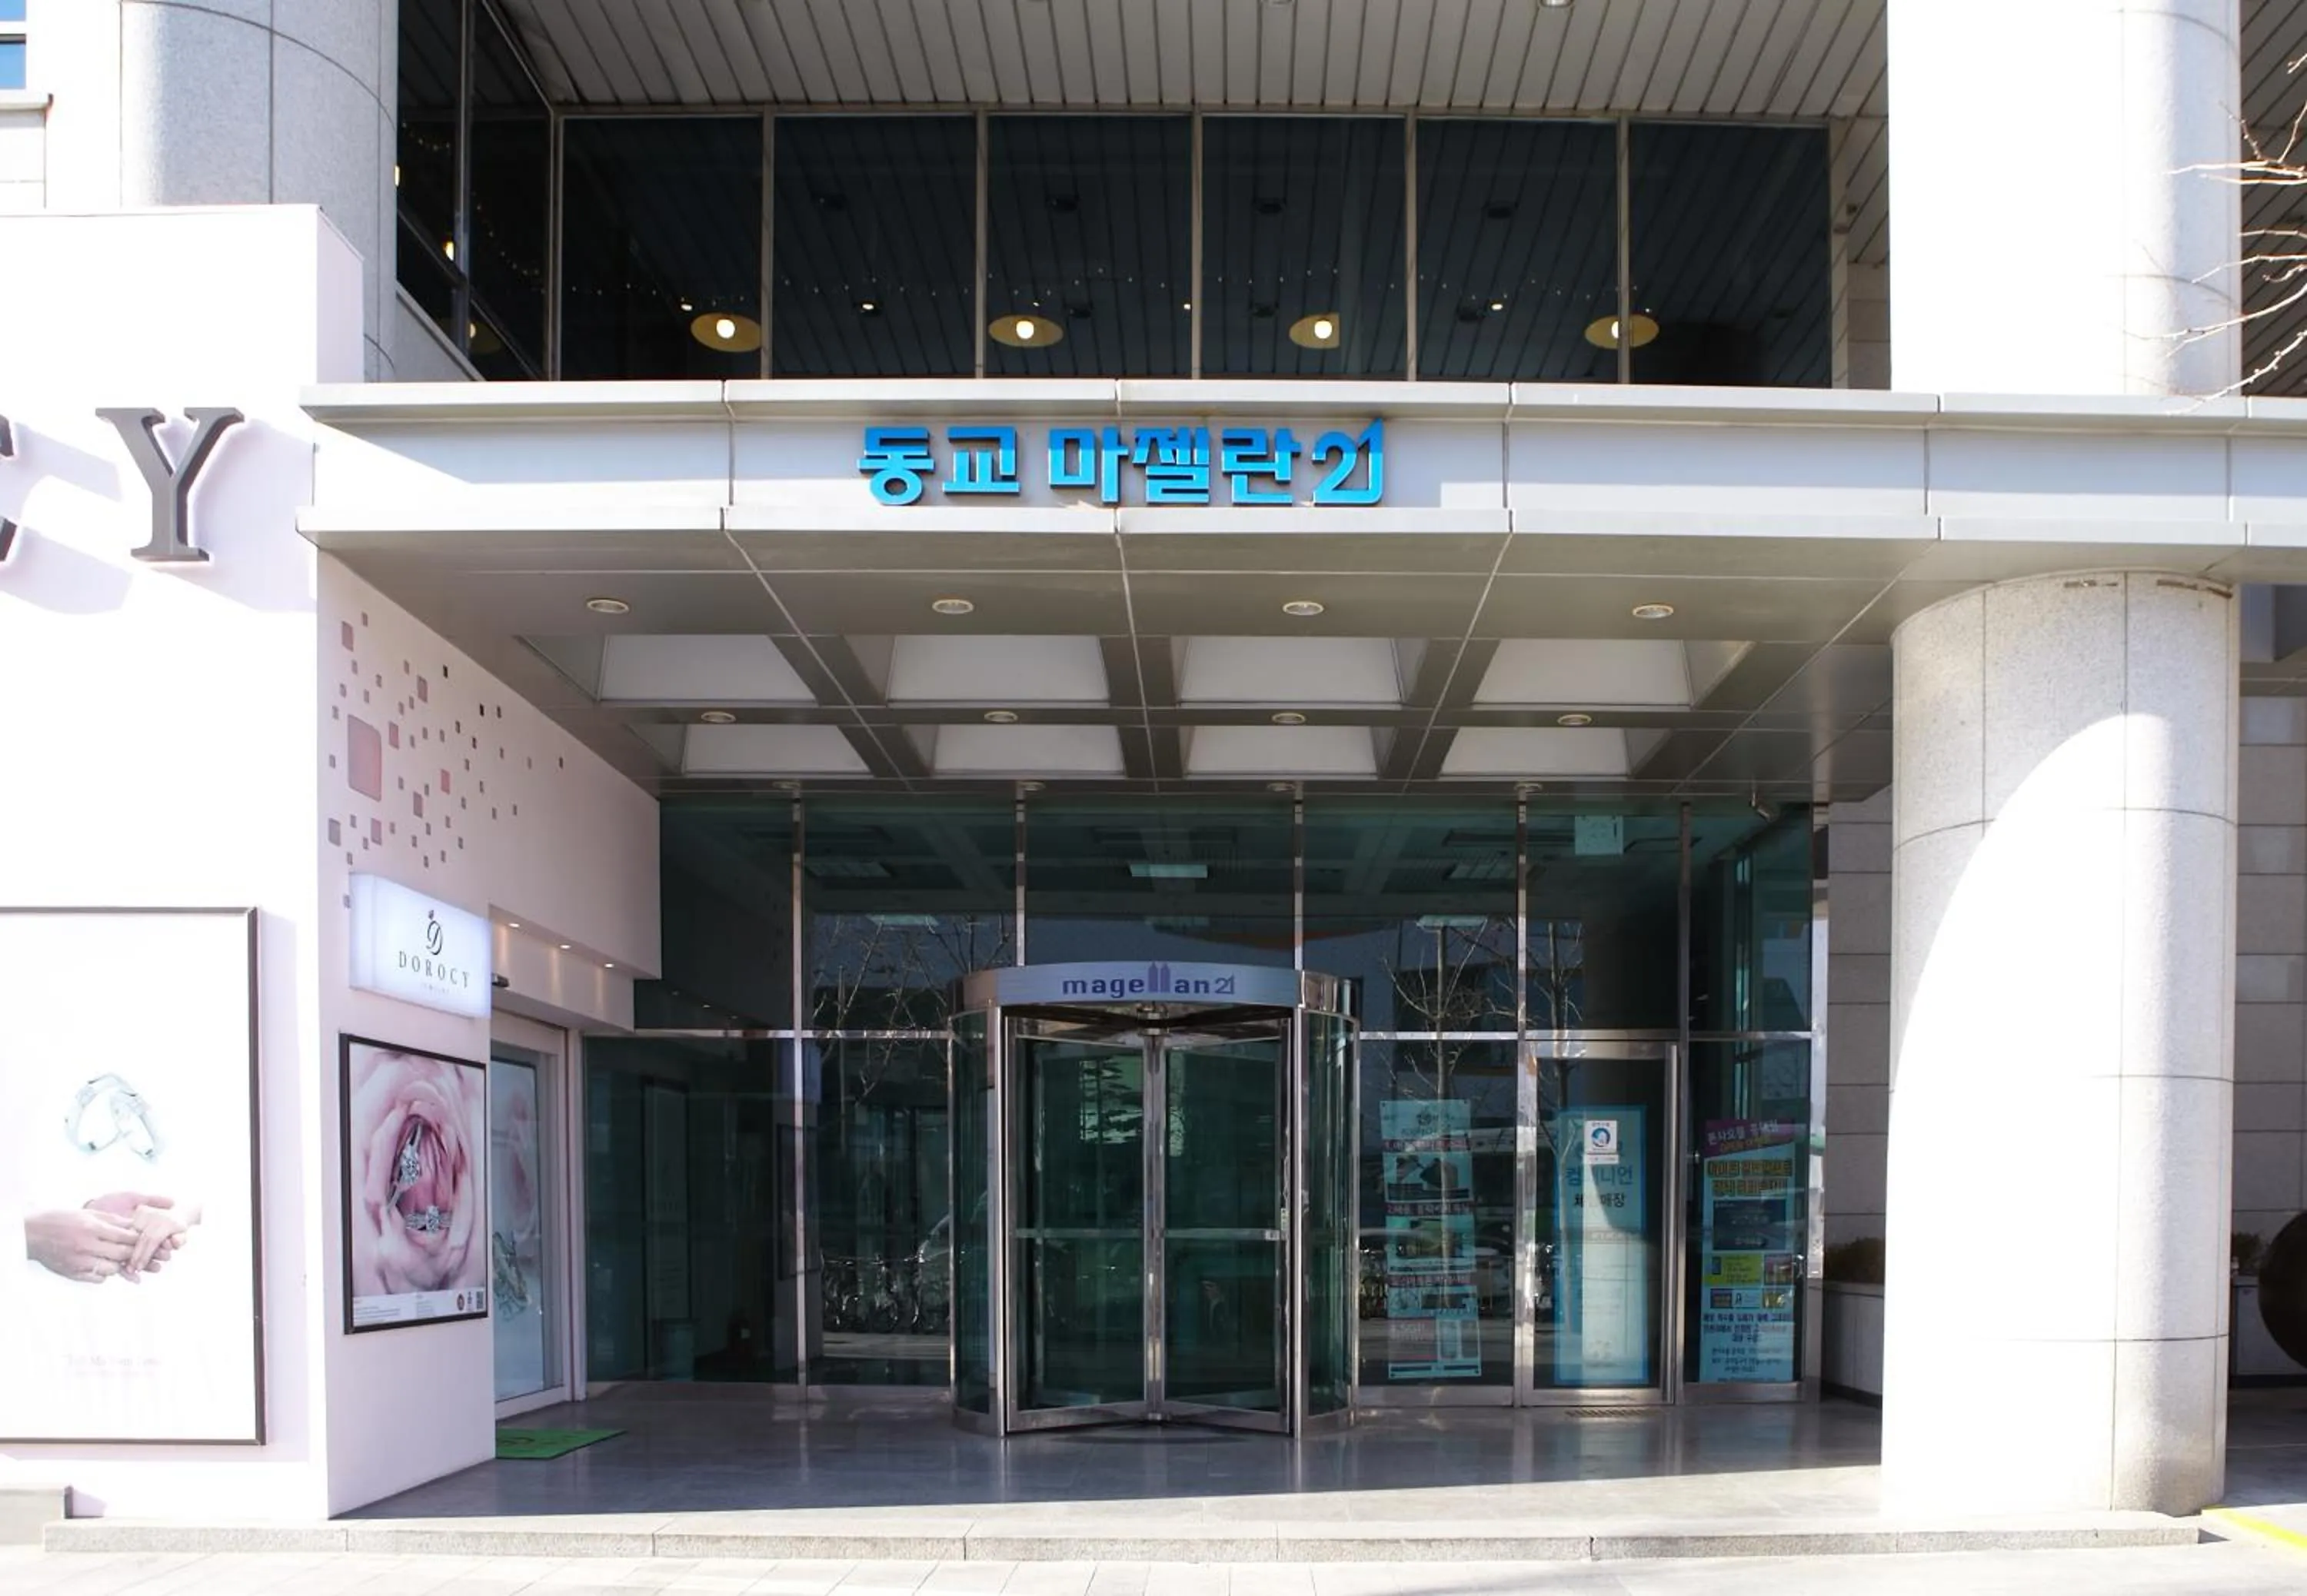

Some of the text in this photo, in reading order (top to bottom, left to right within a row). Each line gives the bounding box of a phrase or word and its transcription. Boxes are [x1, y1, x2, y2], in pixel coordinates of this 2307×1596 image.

[0, 407, 245, 563] Y
[856, 417, 1383, 506] 동교 마젤란21
[399, 950, 470, 989] DOROCY
